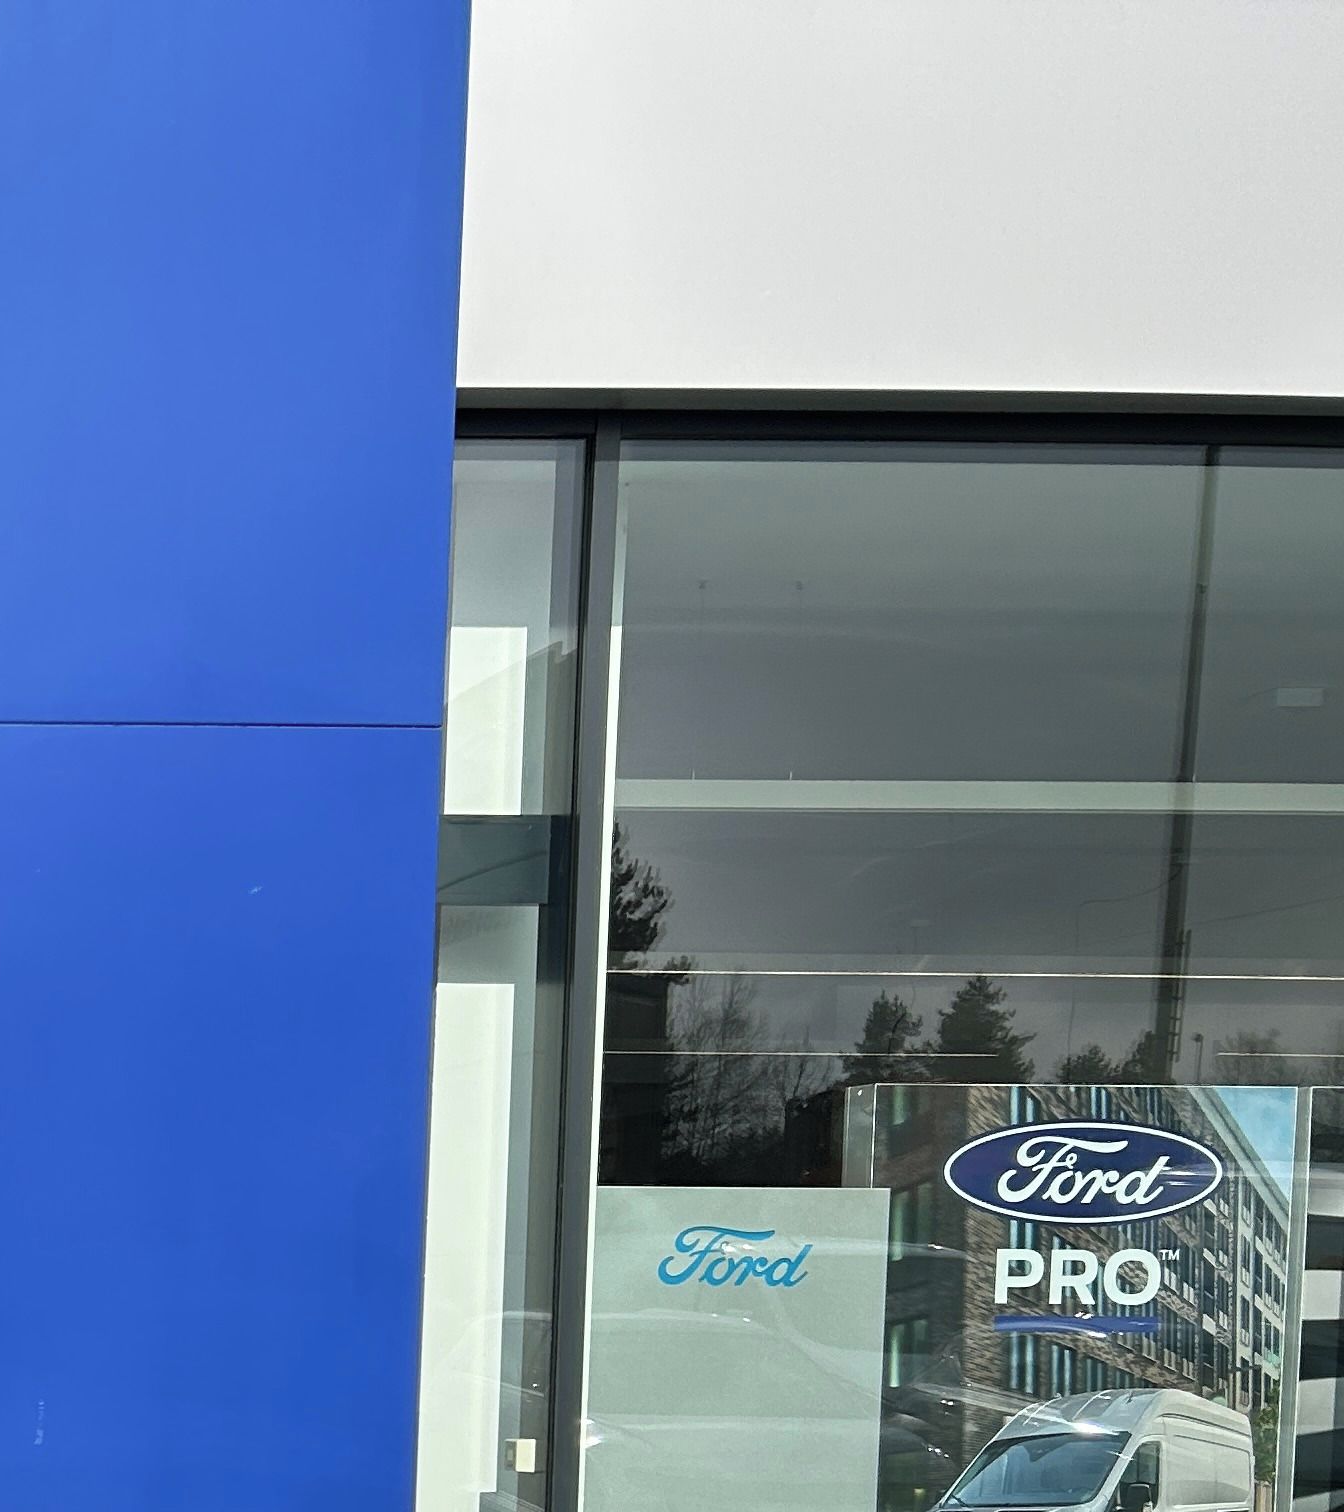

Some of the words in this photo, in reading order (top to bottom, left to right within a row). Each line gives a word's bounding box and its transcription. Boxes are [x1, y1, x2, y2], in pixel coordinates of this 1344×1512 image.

[996, 1135, 1170, 1207] Ford
[657, 1225, 813, 1288] Ford
[994, 1248, 1162, 1305] PRO
